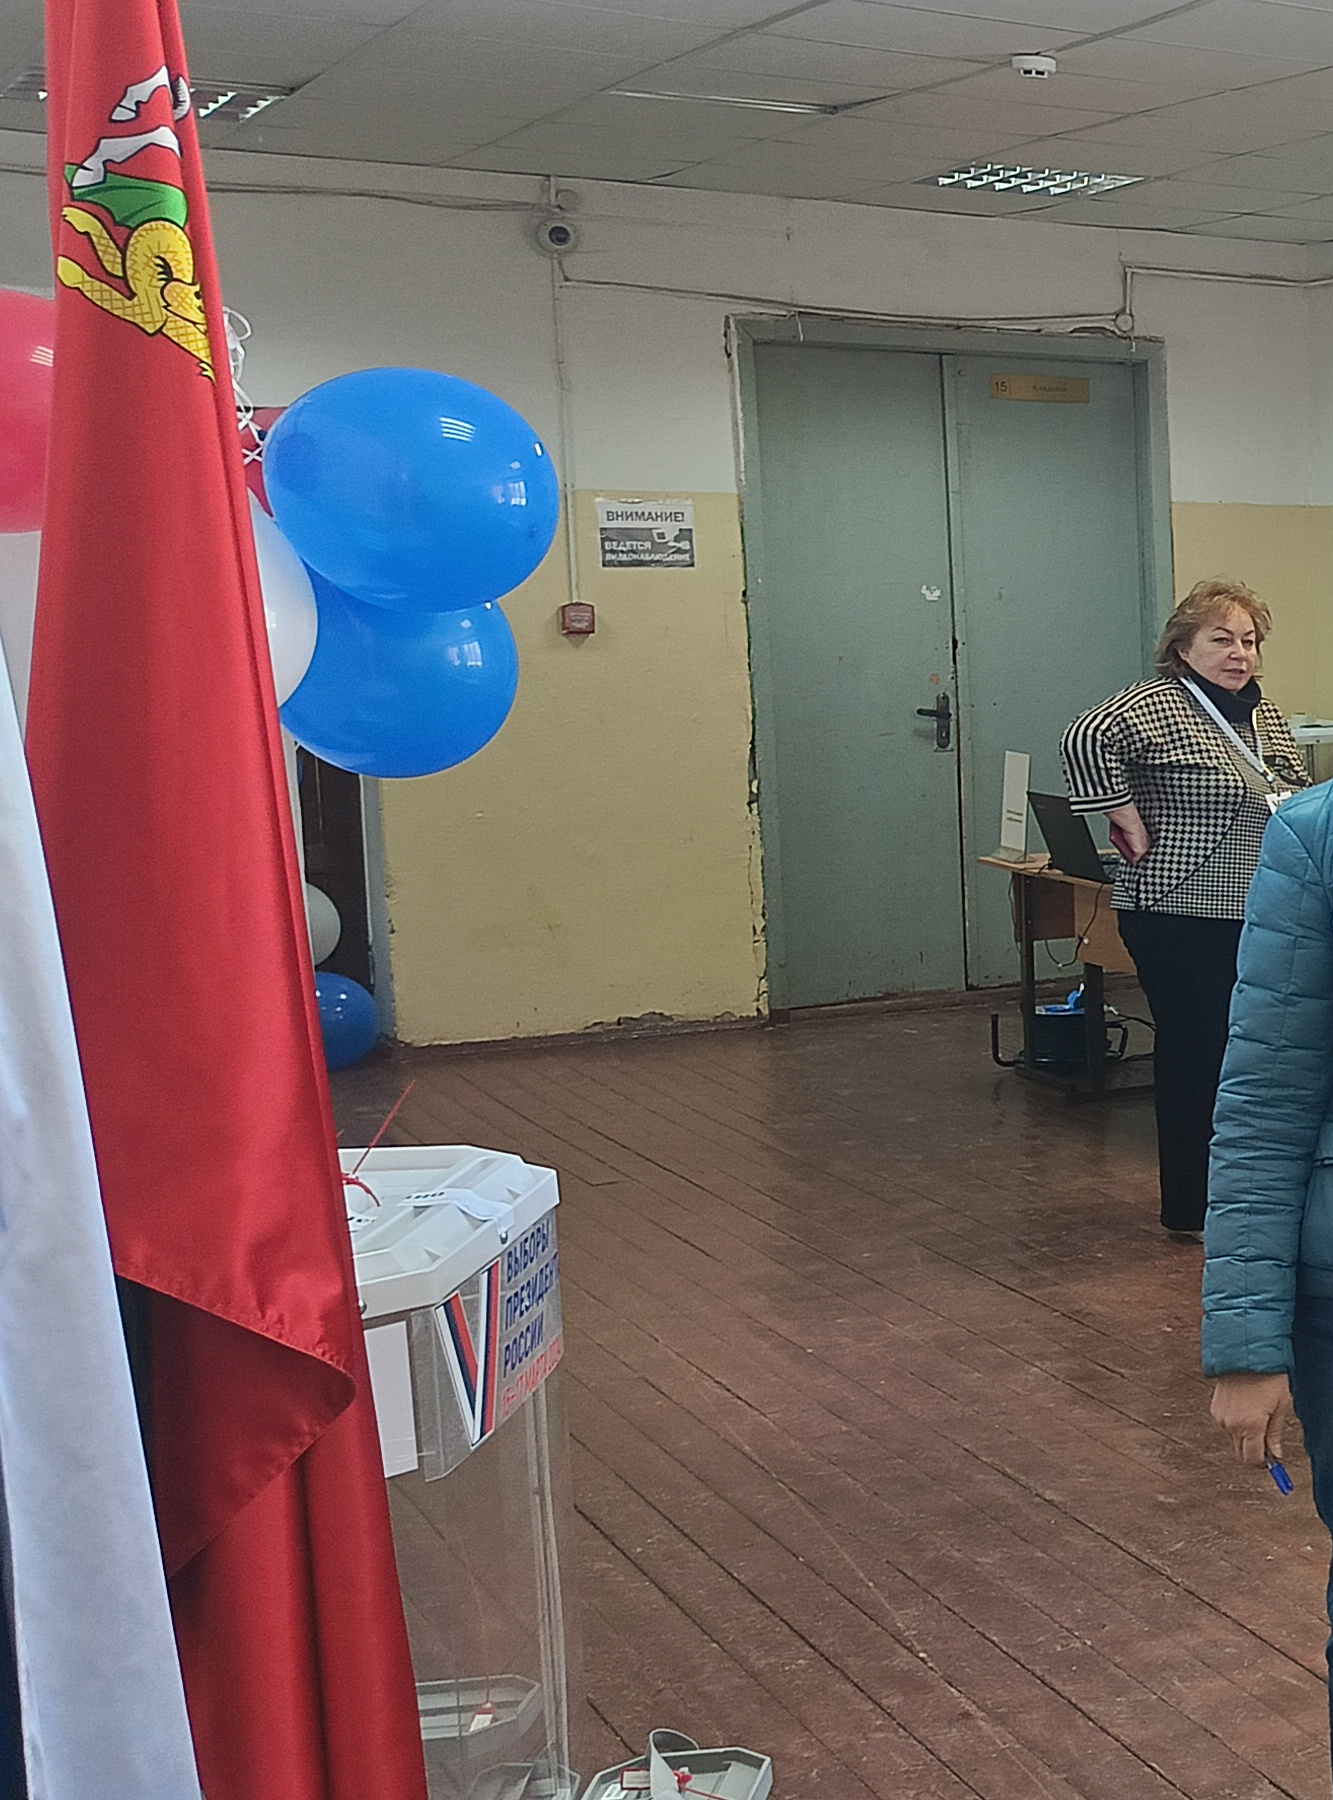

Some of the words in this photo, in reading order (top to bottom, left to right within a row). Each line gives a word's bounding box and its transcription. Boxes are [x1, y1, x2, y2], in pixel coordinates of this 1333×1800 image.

[994, 381, 1008, 393] 15
[606, 510, 685, 523] ВНИМАНИЕ!
[604, 541, 652, 551] ВЕДЕТСЯ
[506, 1218, 550, 1285] ВЫБОРЫ
[504, 1251, 560, 1331] ПРЕЗИДЕНТ
[503, 1311, 545, 1379] РОССИИ
